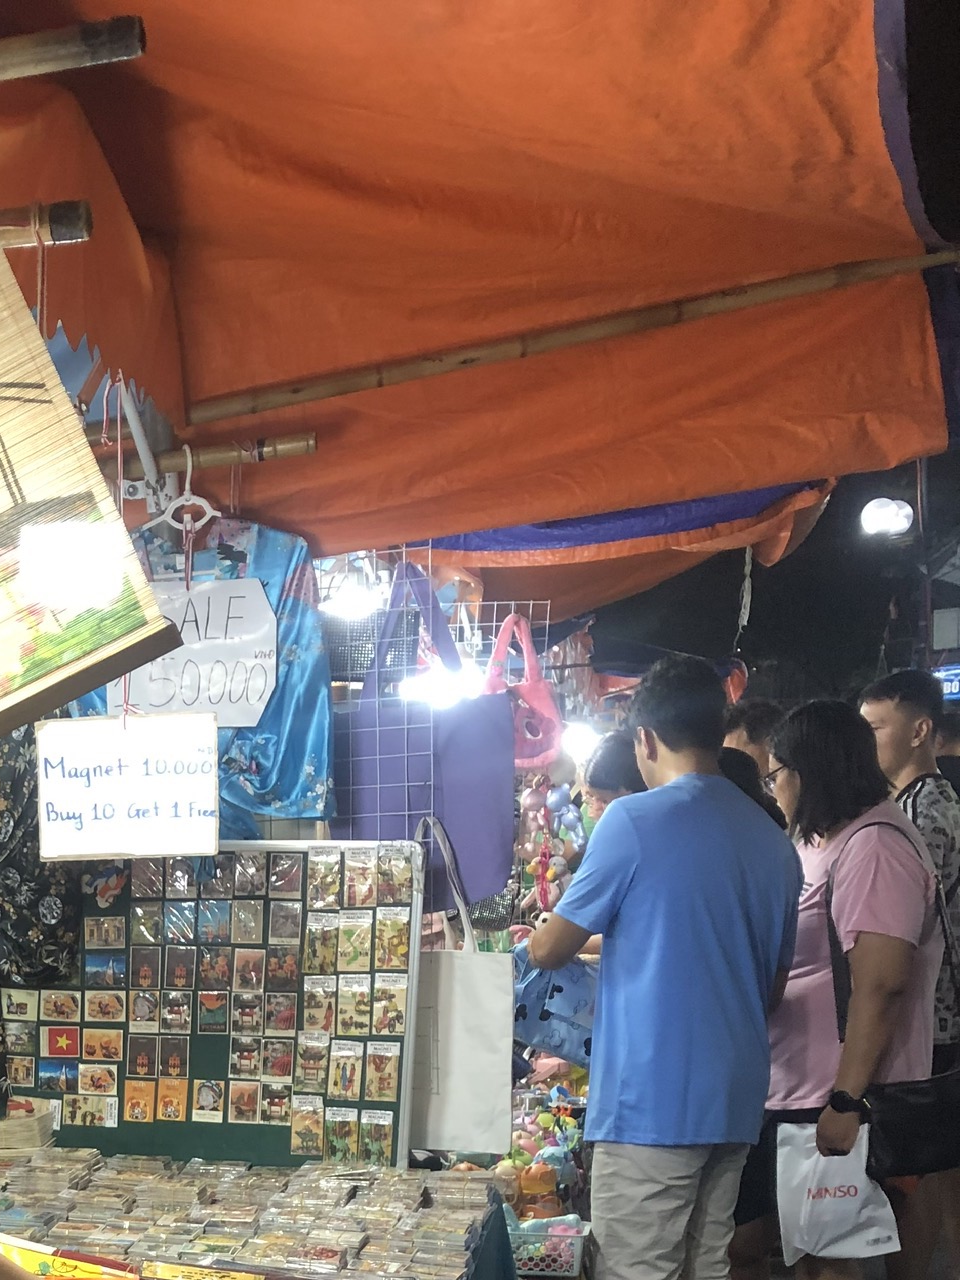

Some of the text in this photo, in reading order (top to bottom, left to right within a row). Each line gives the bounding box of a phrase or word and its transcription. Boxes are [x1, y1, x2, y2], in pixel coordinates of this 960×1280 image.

[43, 757, 213, 788] Magnet 10.000
[46, 801, 83, 831] Buy
[91, 802, 115, 821] 10
[127, 801, 160, 819] Get
[172, 801, 182, 818] 1
